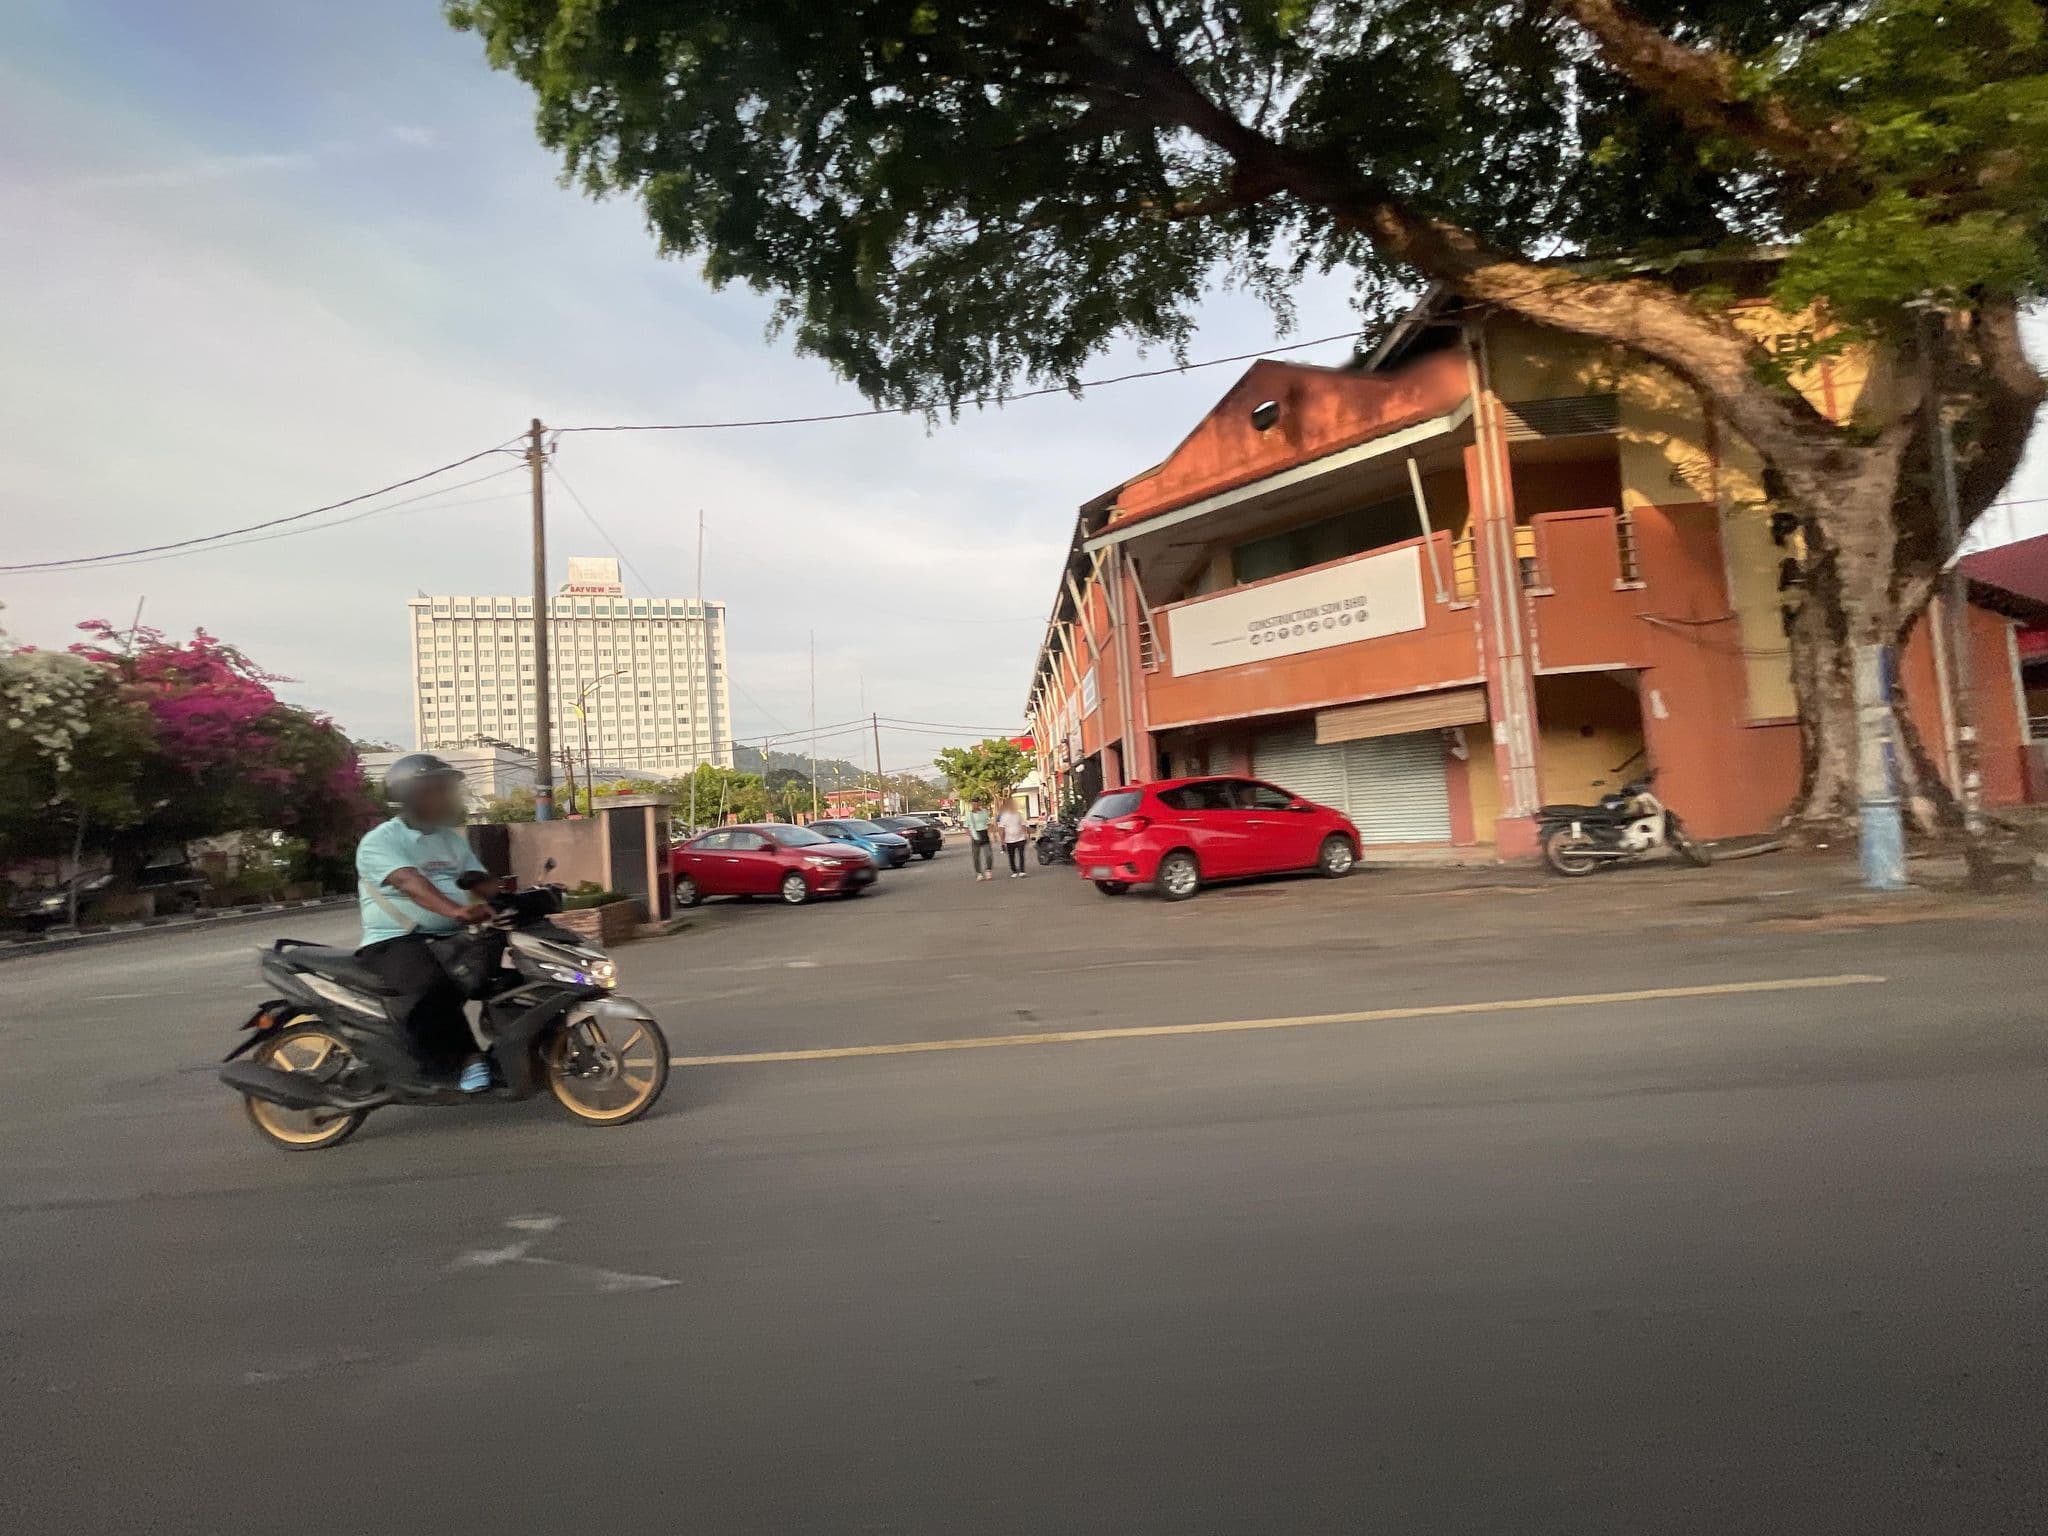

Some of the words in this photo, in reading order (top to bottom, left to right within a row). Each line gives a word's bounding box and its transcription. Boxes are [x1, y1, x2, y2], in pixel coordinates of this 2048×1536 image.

[1248, 607, 1319, 632] CONSTRUCTION
[1320, 600, 1342, 616] SDN
[1343, 595, 1368, 611] BHD
